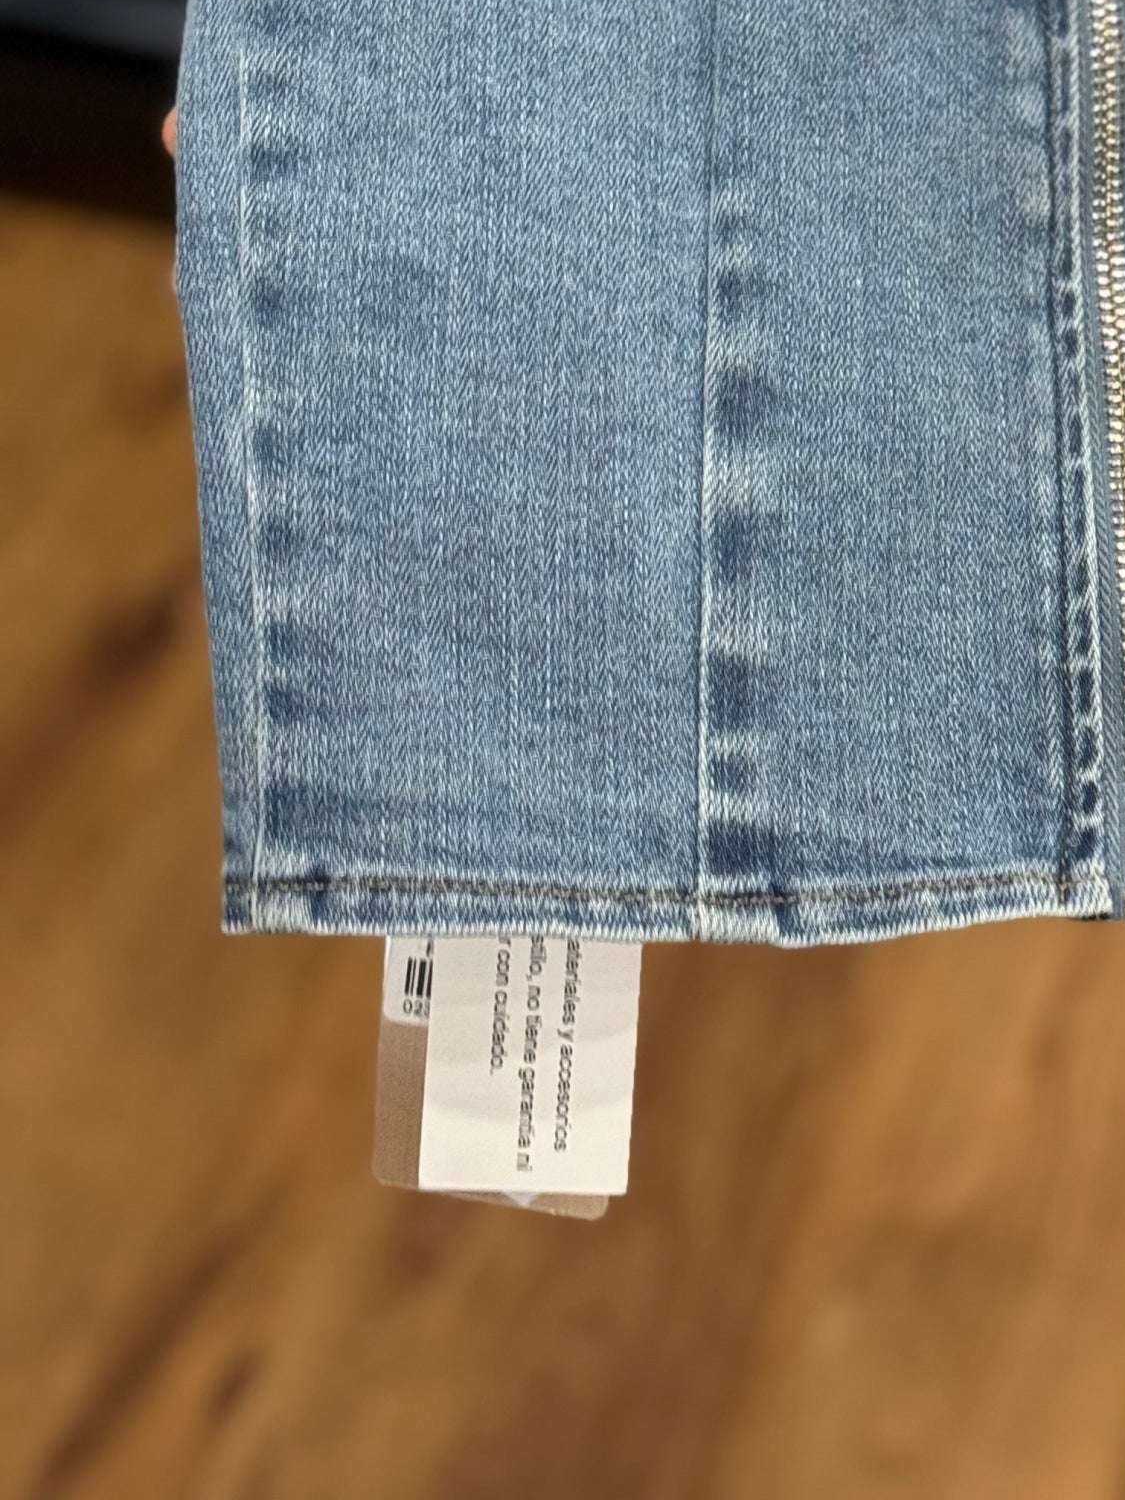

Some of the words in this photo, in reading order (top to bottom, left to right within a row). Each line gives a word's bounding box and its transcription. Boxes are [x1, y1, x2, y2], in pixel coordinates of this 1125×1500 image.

[496, 949, 511, 986] con
[526, 934, 548, 981] stilo,
[526, 985, 542, 1011] no
[562, 938, 583, 1025] ateriales
[490, 990, 510, 1076] cuidado.
[523, 1015, 543, 1064] tiene
[557, 1028, 574, 1043] y
[554, 1044, 574, 1153] accesorios
[516, 1152, 533, 1172] ni
